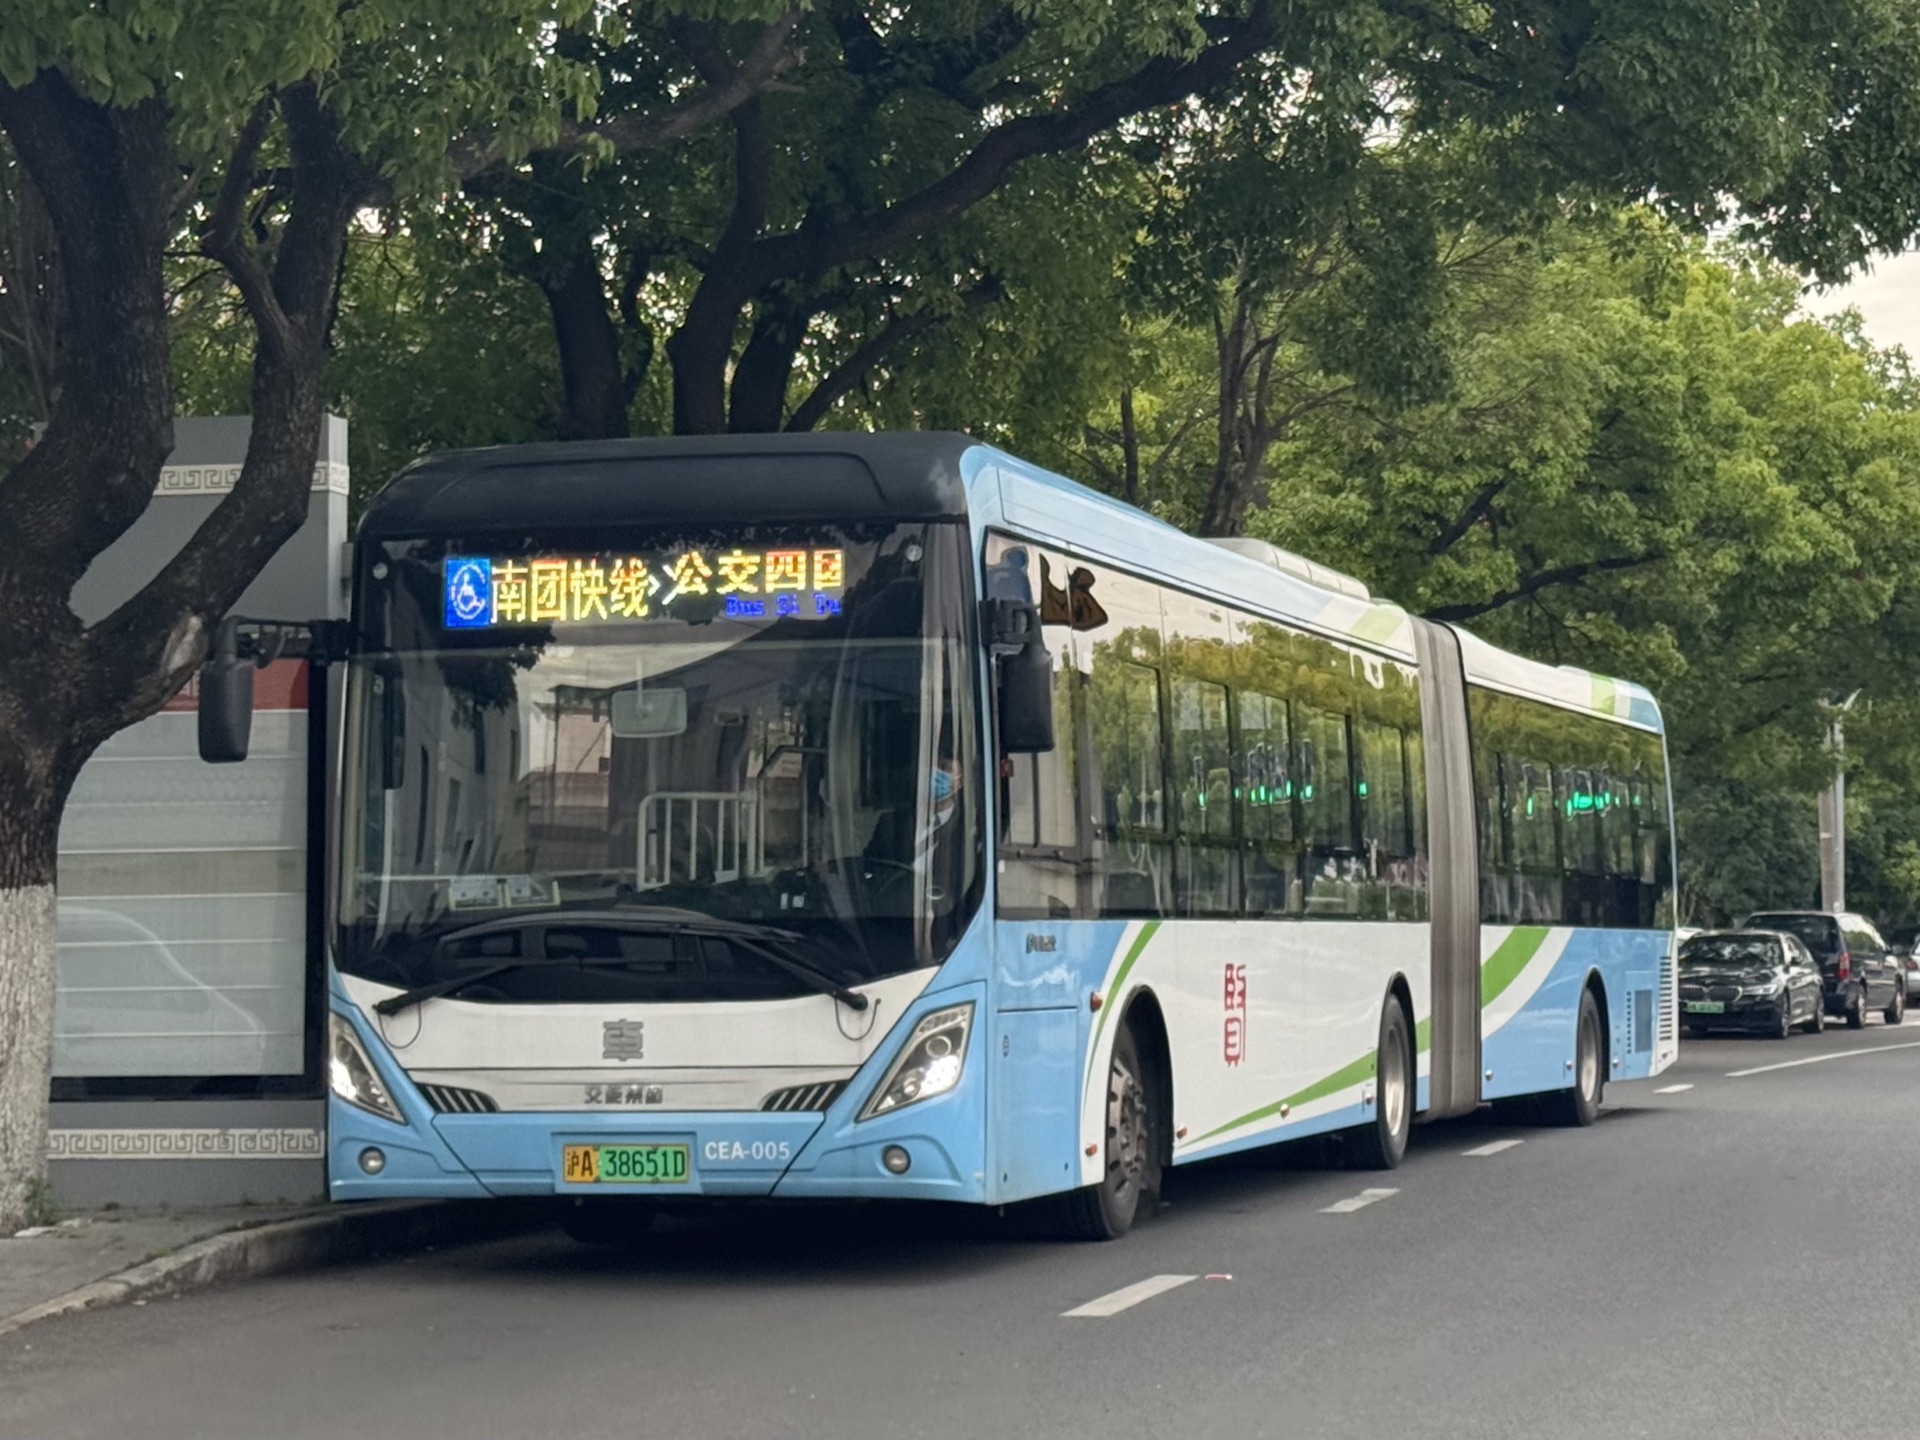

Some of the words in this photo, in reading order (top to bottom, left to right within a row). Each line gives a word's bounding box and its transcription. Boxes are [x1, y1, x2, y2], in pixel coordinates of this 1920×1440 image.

[491, 553, 649, 622] 南团快线
[604, 1149, 686, 1178] 38651D
[704, 1140, 790, 1161] CEA-005
